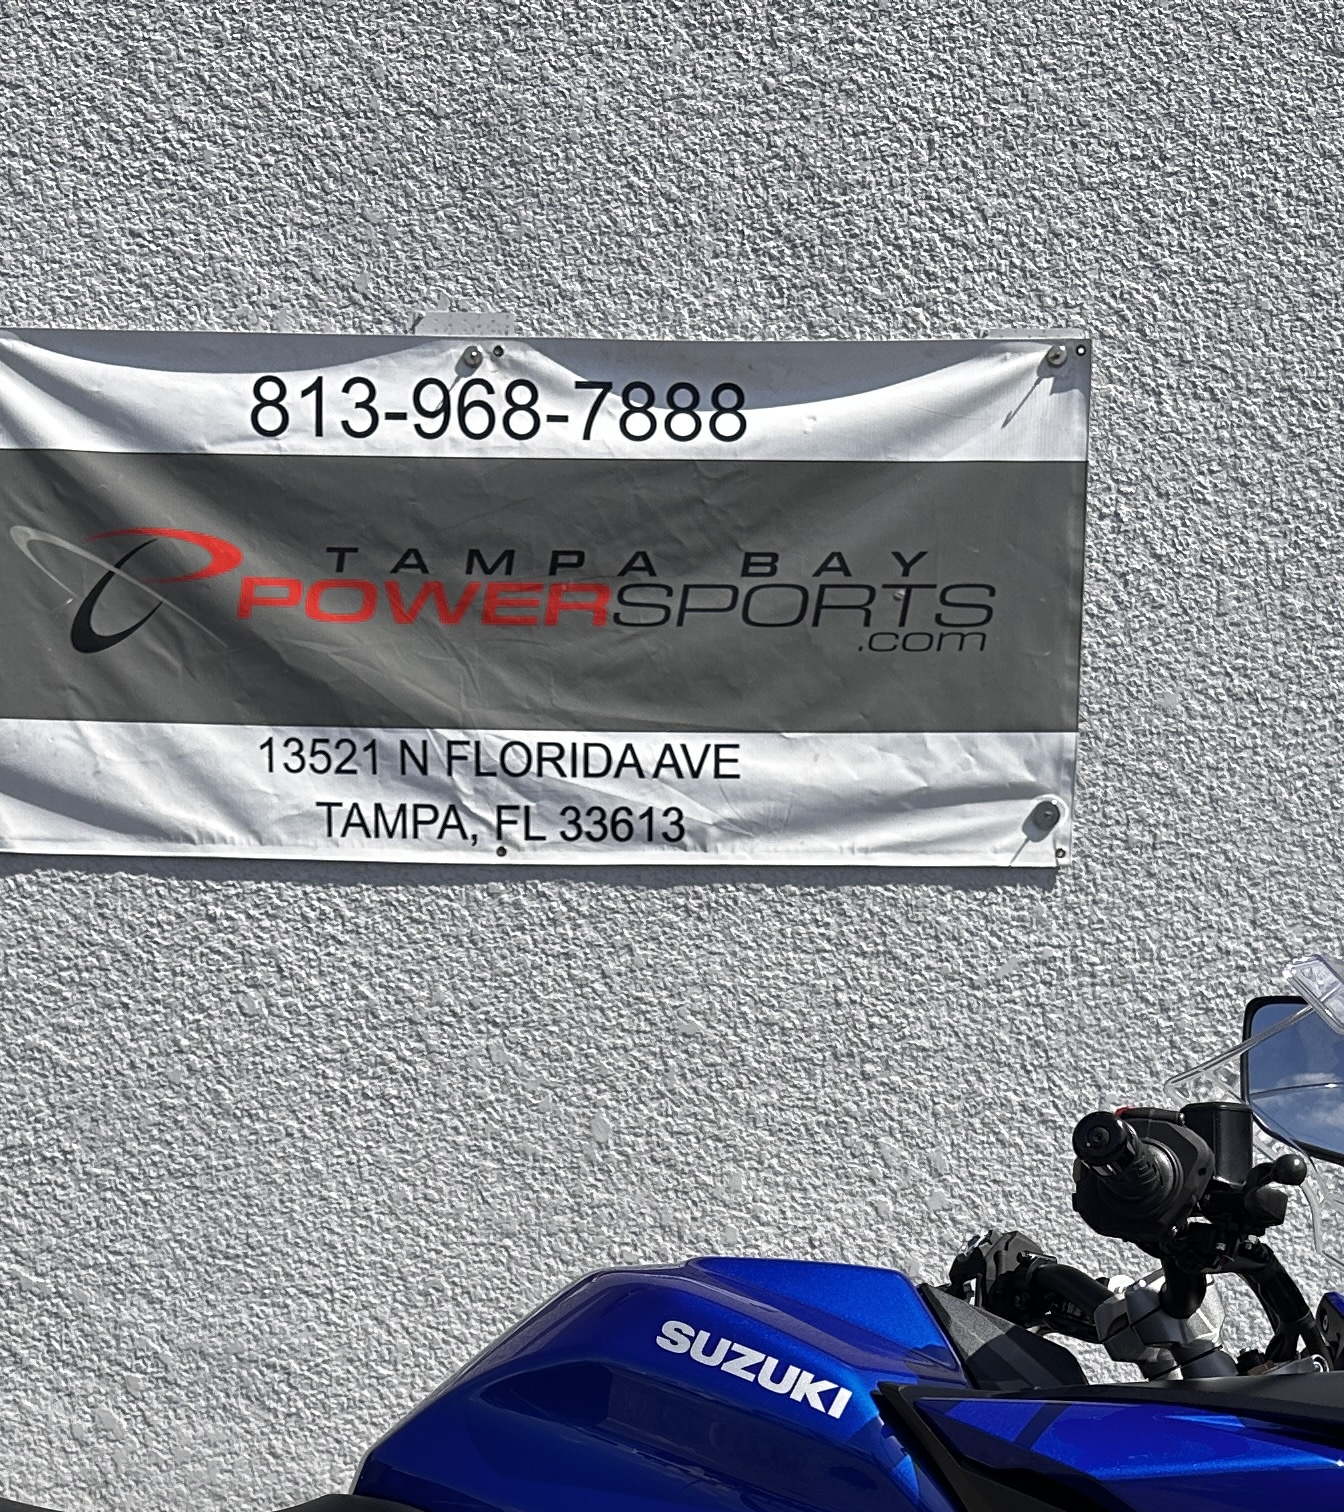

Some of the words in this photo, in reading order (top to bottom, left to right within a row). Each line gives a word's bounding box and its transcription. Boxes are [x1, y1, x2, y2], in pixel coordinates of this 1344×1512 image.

[250, 375, 747, 442] 813-968-7888
[325, 546, 657, 578] TAMPA
[740, 551, 929, 579] BAY
[237, 575, 998, 629] POWERSPORTS
[857, 631, 987, 653] .com
[259, 736, 378, 776] 13521
[399, 739, 429, 777] N
[446, 739, 646, 779] FLORIDA
[651, 743, 741, 780] AVE
[315, 801, 478, 847] TAMPA,
[495, 804, 547, 841] FL
[559, 805, 686, 844] 33613
[656, 1320, 853, 1419] SUZUKI
